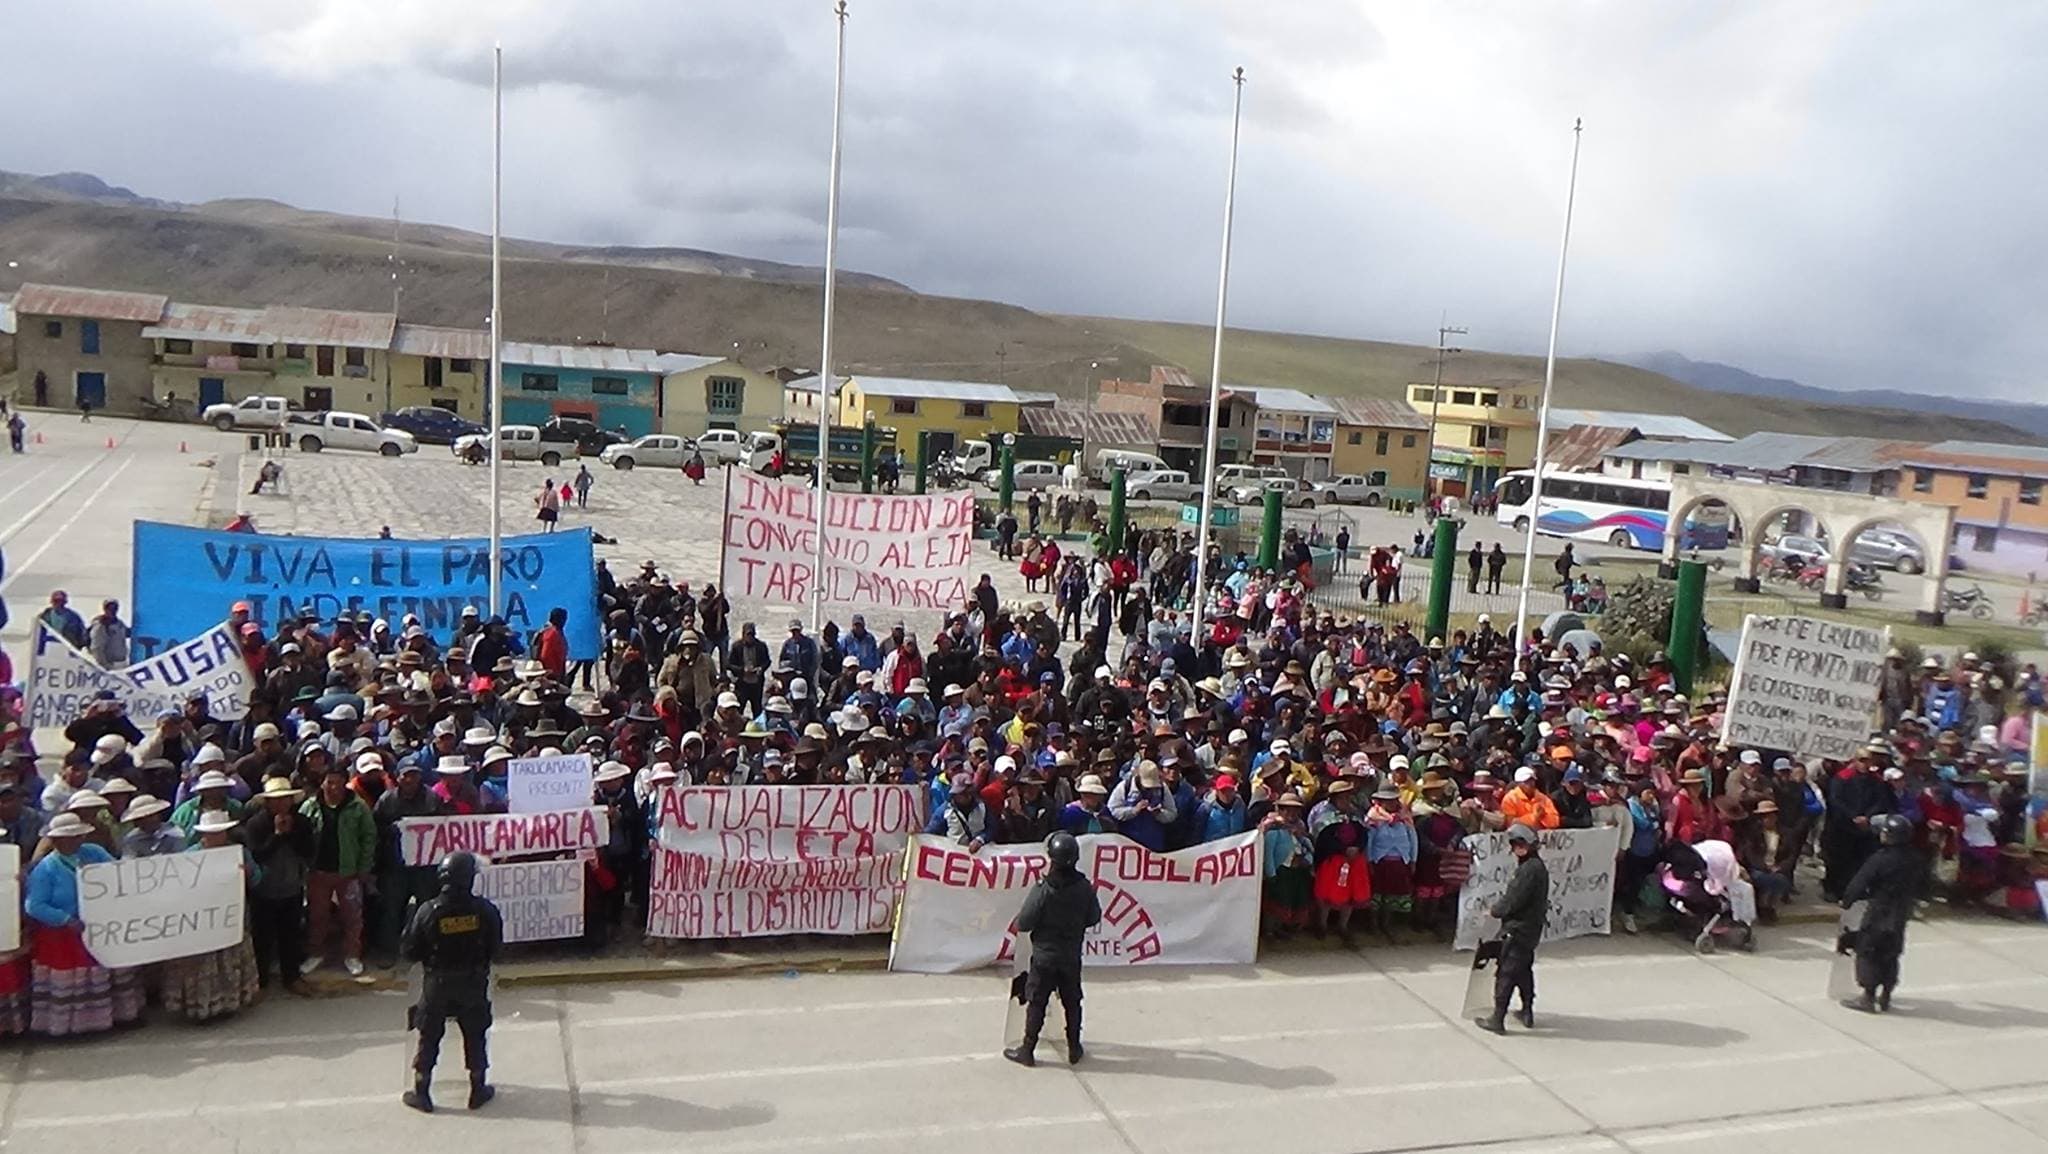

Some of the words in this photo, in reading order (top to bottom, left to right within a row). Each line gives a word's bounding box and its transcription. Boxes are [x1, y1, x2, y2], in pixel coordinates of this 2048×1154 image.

[936, 494, 973, 529] DE
[204, 541, 337, 588] VIVA
[371, 546, 420, 588] EL
[443, 545, 543, 586] PARO
[727, 514, 869, 565] CONVENIO
[879, 540, 915, 569] AL
[658, 786, 924, 834] ACTUALIZACION
[405, 808, 599, 867] TARUCAMARCA
[718, 828, 790, 863] DEL
[81, 853, 208, 901] SIBAY
[650, 848, 712, 892] CANON
[915, 845, 1048, 890] CENTR
[1093, 843, 1255, 888] POBLADO
[87, 902, 241, 947] PRESENTE
[513, 913, 584, 939] URGENTE
[649, 890, 707, 938] PARA
[712, 890, 743, 938] EL
[747, 887, 845, 936] DISTRITO
